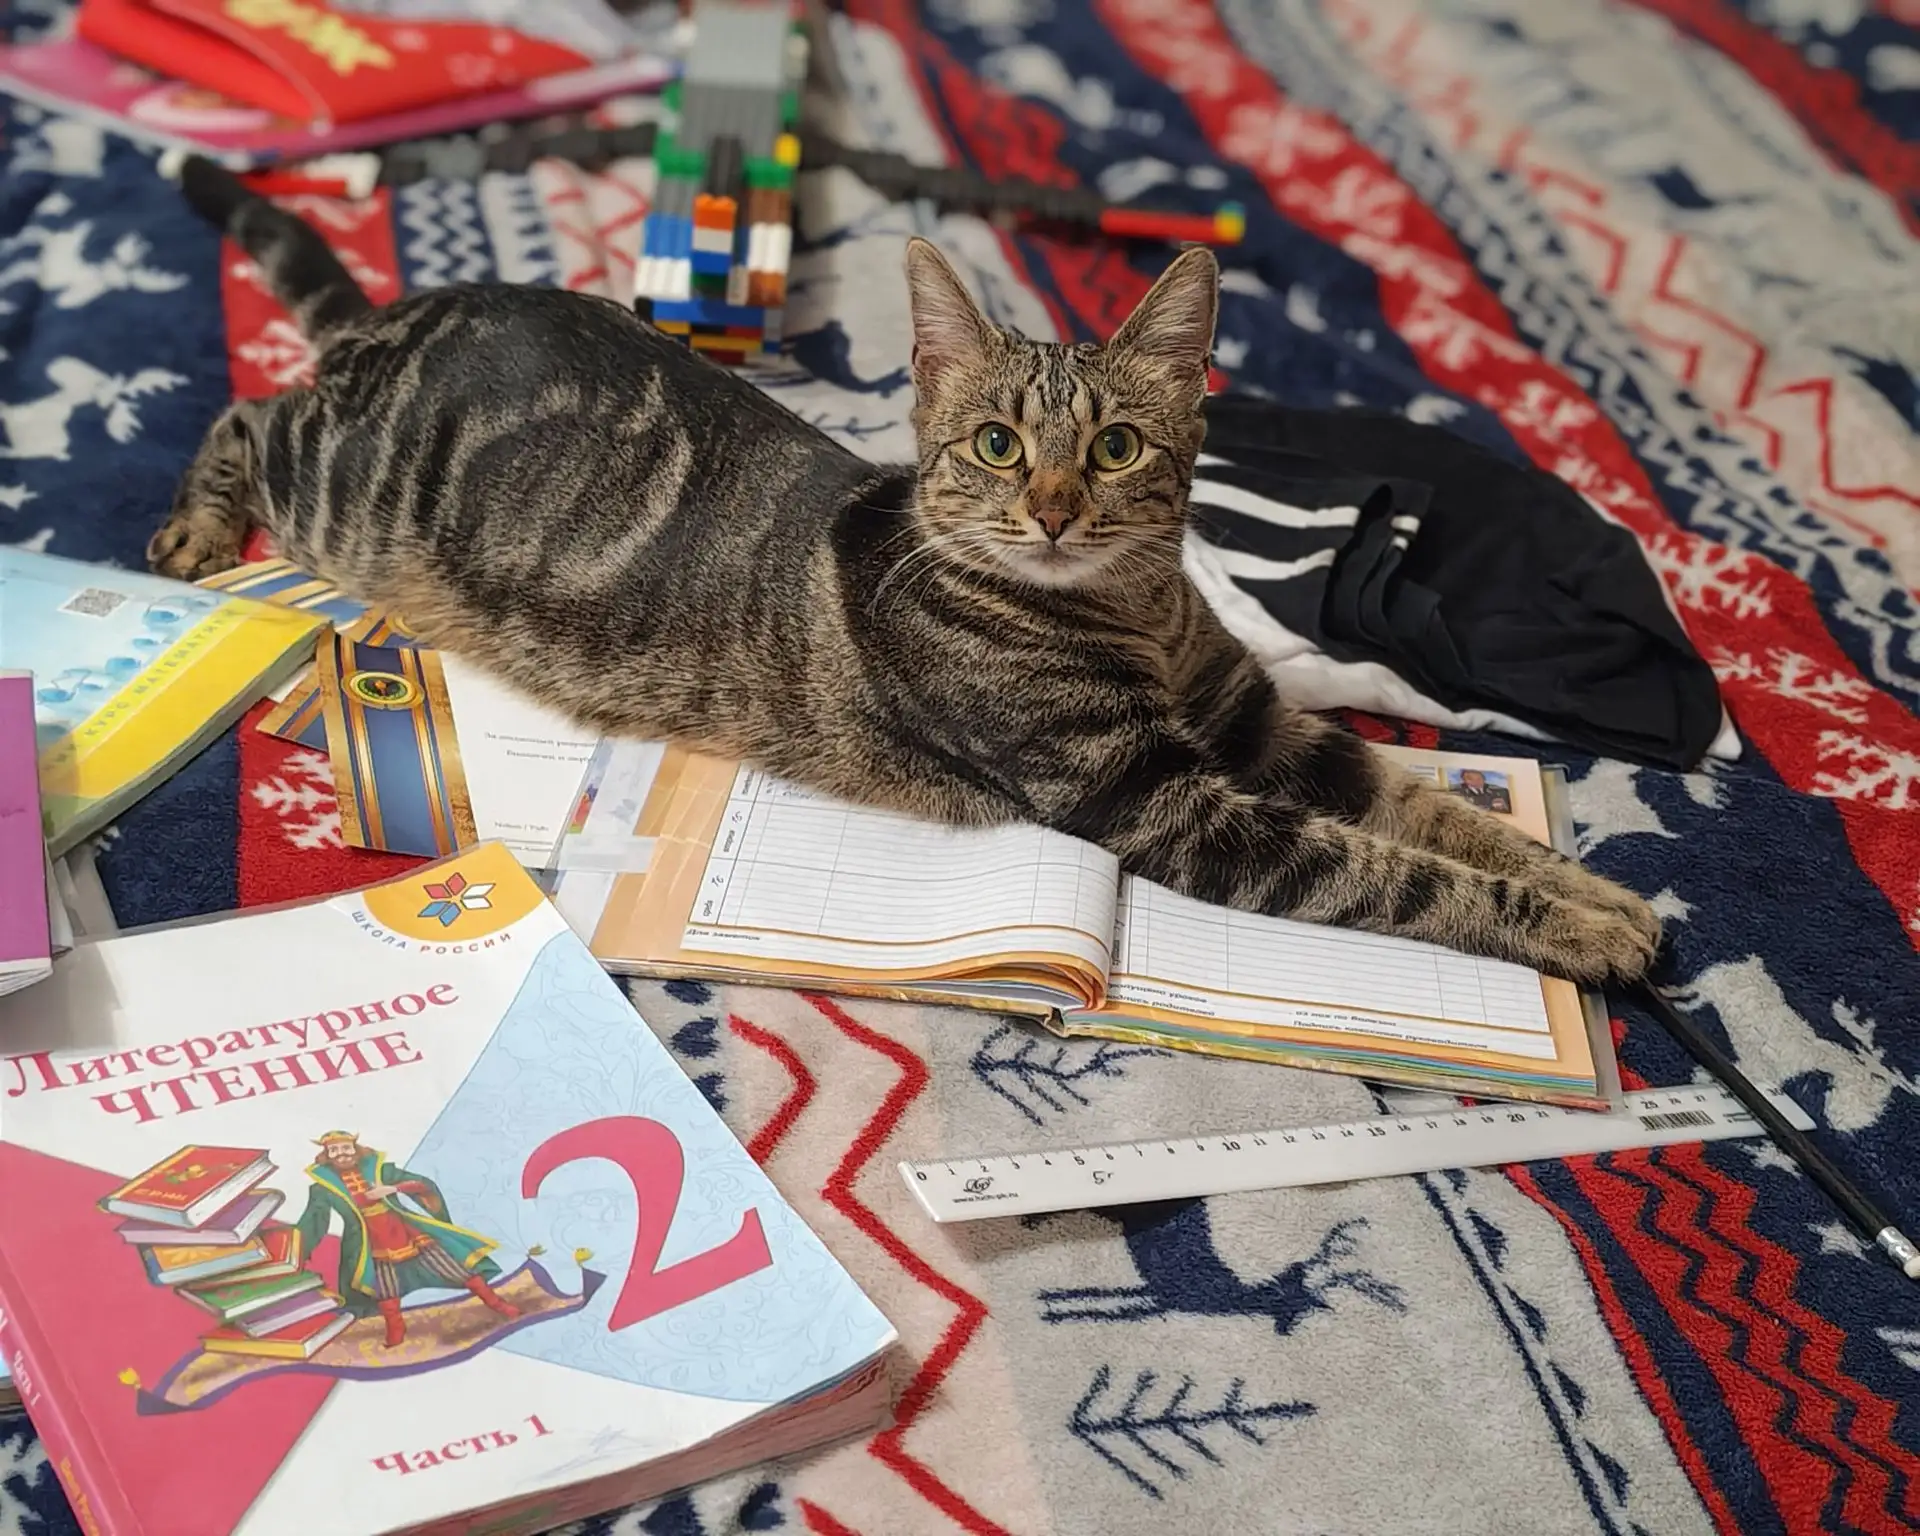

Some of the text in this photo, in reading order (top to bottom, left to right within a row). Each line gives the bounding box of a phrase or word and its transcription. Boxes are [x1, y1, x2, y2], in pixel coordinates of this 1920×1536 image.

[352, 911, 512, 955] ШКОЛА РОССИИ
[3, 983, 460, 1098] Литературное
[91, 1031, 425, 1125] ЧТЕНИЕ
[1222, 1141, 1241, 1152] 10
[1367, 1127, 1387, 1138] 15
[1507, 1112, 1527, 1124] 20
[1642, 1100, 1659, 1110] 25
[521, 1115, 774, 1332] 2
[369, 1413, 554, 1476] Часть 1
